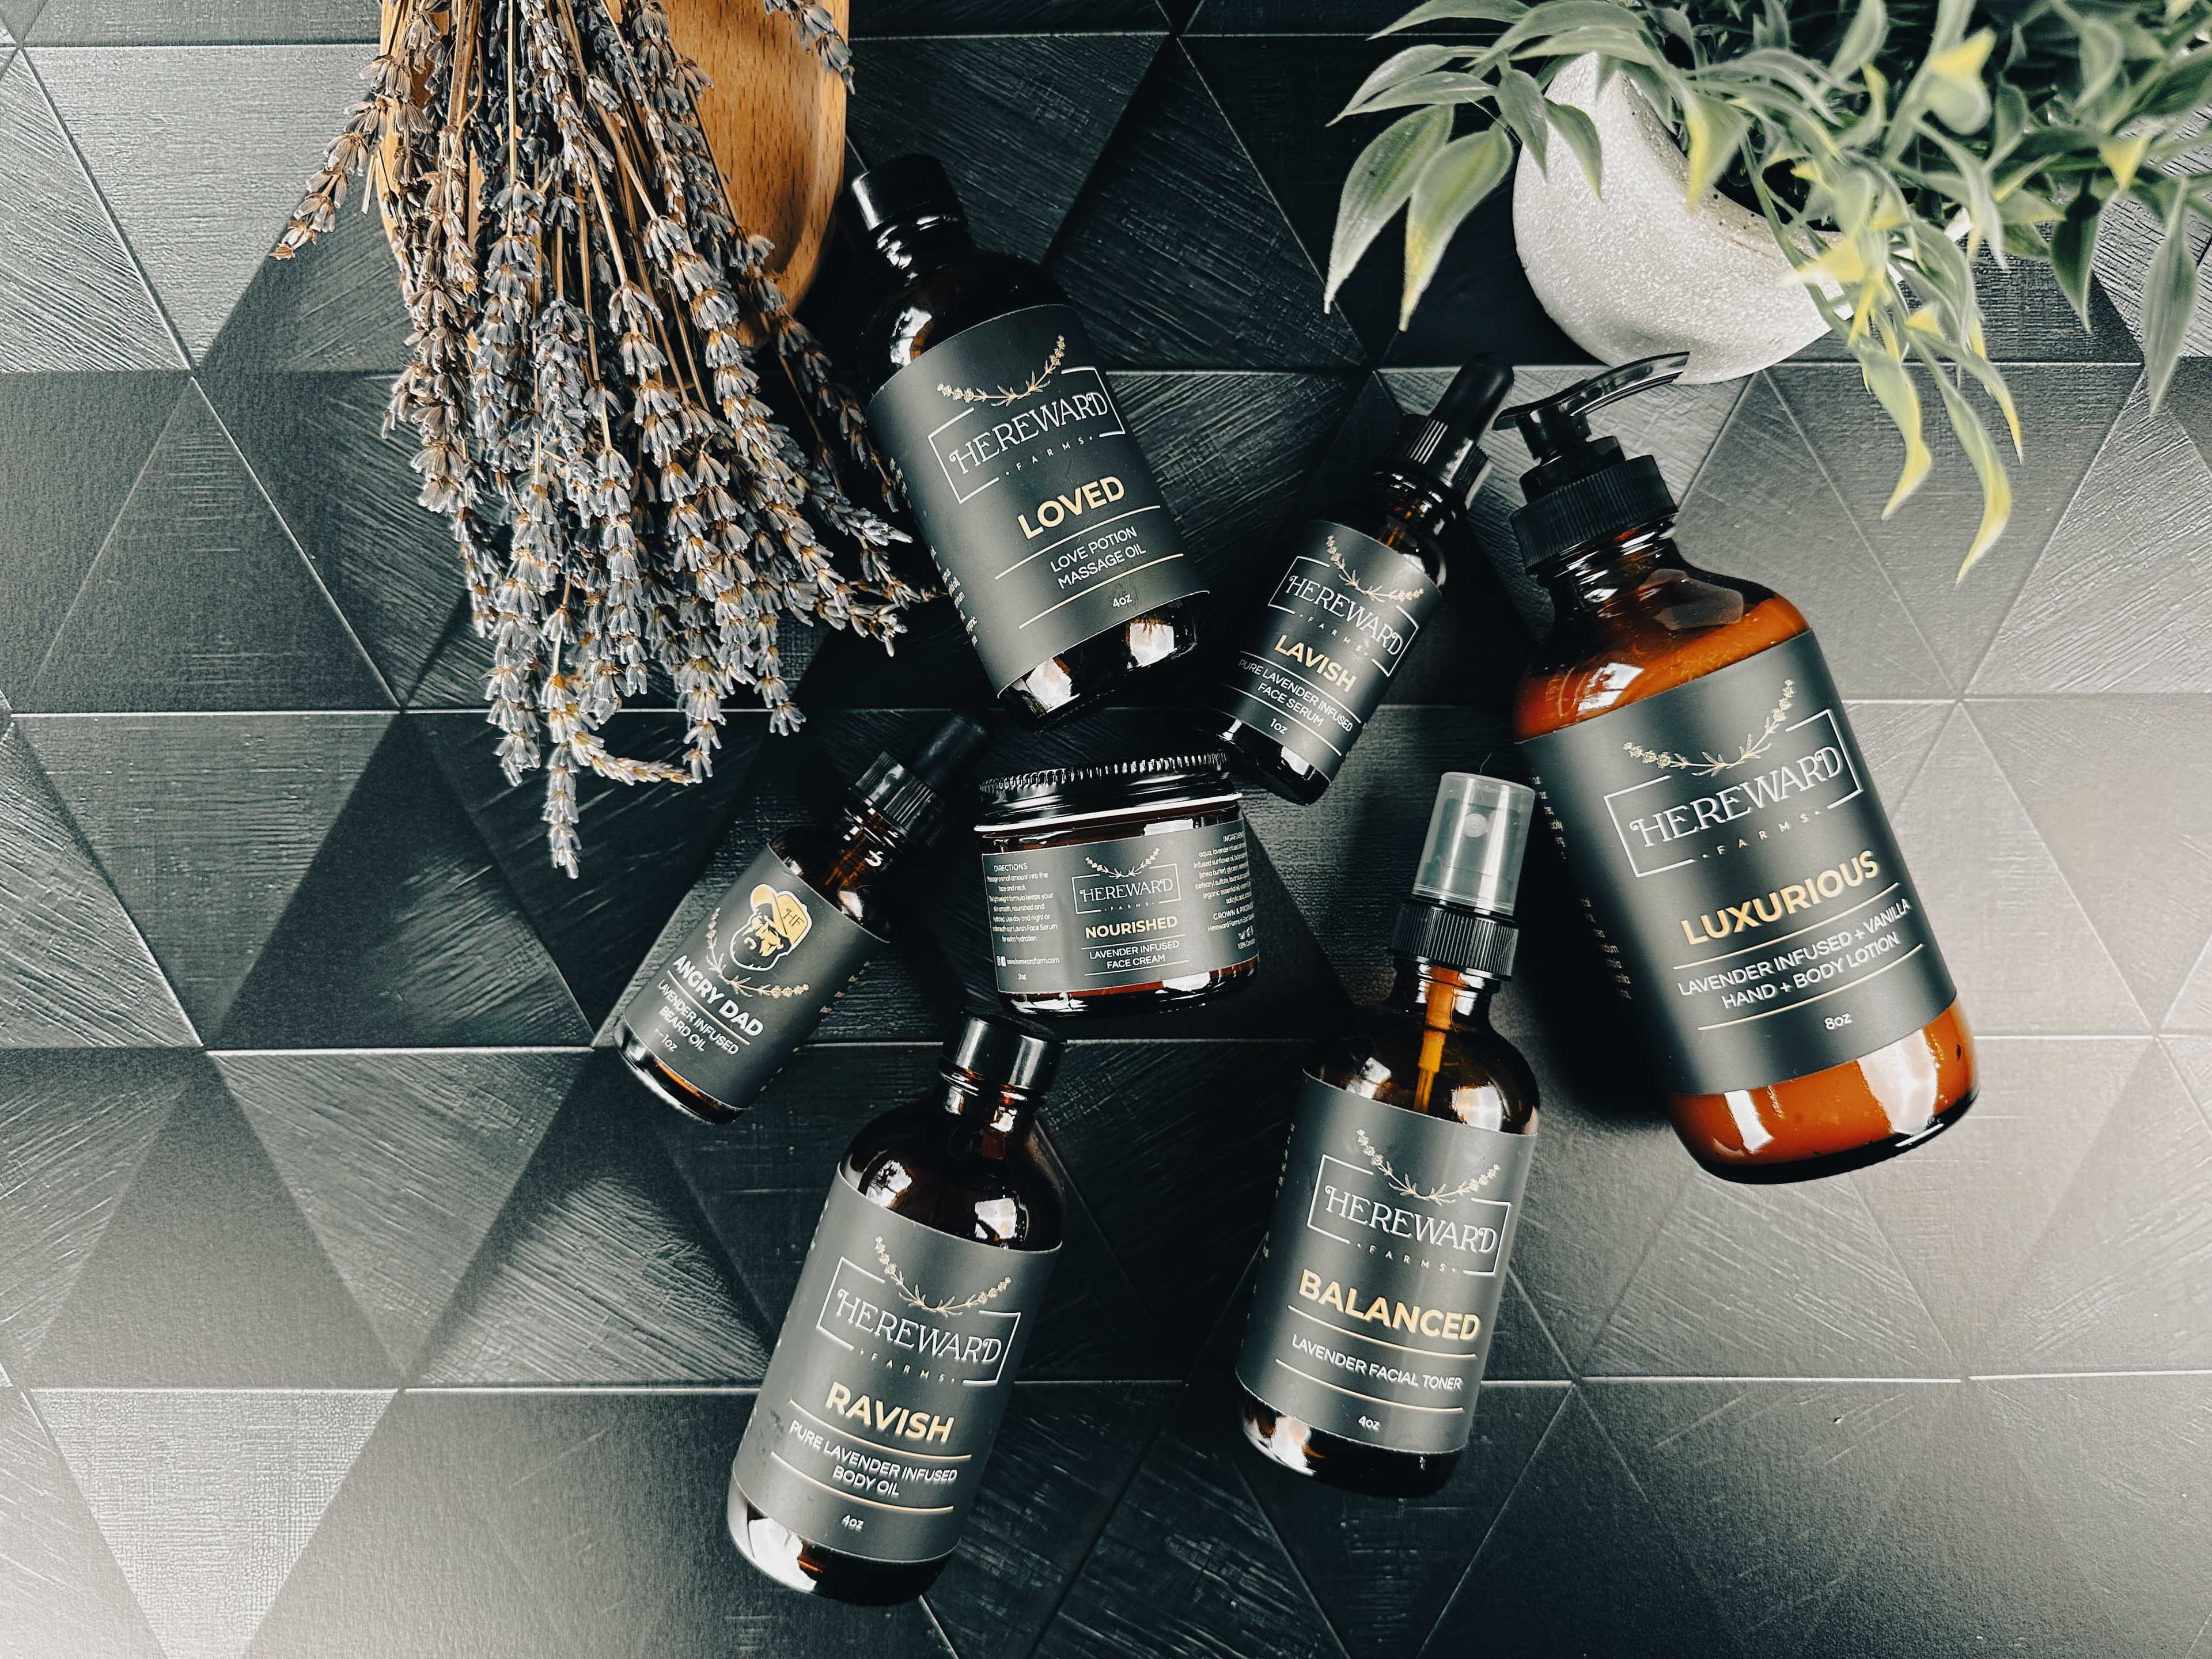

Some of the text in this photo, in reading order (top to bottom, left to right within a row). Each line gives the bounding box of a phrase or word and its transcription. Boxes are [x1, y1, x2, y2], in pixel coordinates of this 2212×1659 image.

[948, 391, 1108, 474] HEREWARD
[1016, 437, 1085, 472] FARMS
[1017, 476, 1125, 539] LOVED
[1050, 527, 1137, 572] LOVE POTION
[1057, 545, 1146, 589] MASSAGE OIL
[1112, 594, 1132, 608] 4oz
[1285, 574, 1403, 656] HEREWARD
[1308, 616, 1362, 652] FARMS
[1274, 635, 1357, 693] LAVISH
[1237, 659, 1354, 732] PURE LAVENDER INFUSED
[1257, 682, 1325, 727] FACE SERUM
[1270, 718, 1288, 735] 1oz
[1629, 745, 1842, 848] HEREWARD
[1717, 813, 1808, 855] FARMS
[994, 863, 1028, 872] DIRECTIONS
[1025, 893, 1041, 902] keeps
[1041, 892, 1054, 902] your
[1079, 878, 1173, 903] HEREWARD
[1110, 902, 1149, 911] FARMS
[1681, 850, 1880, 946] LUXURIOUS
[783, 908, 805, 926] HF
[1031, 913, 1044, 922] night
[1085, 915, 1178, 939] NOURISHED
[1207, 921, 1229, 932] Hereward
[1213, 909, 1236, 921] GROWN
[1089, 940, 1180, 960] LAVENDER INFUSED
[1106, 953, 1166, 969] FACE CREAM
[1677, 898, 1912, 997] LAVENDER INFUSED + VANILLA
[1721, 932, 1900, 1010] HAND + BODY LOTION
[672, 954, 764, 1037] ANGRY DAD
[658, 979, 740, 1055] LAVENDER INFUSED
[658, 1005, 706, 1052] BEARD OIL
[1824, 1012, 1853, 1031] 8oz
[1324, 1184, 1497, 1254] HEREWARD
[1370, 1244, 1445, 1272] FARMS
[1299, 1268, 1481, 1340] BALANCED
[836, 1288, 1001, 1363] HEREWARD
[870, 1352, 945, 1382] FARMS
[1291, 1334, 1463, 1391] LAVENDER FACIAL TONER
[825, 1381, 955, 1443] RAVISH
[1358, 1415, 1380, 1431] 4oz
[789, 1419, 957, 1484] PURE LAVENDER INFUSED
[832, 1465, 899, 1497] BODY OIL
[842, 1514, 863, 1531] 4oz
